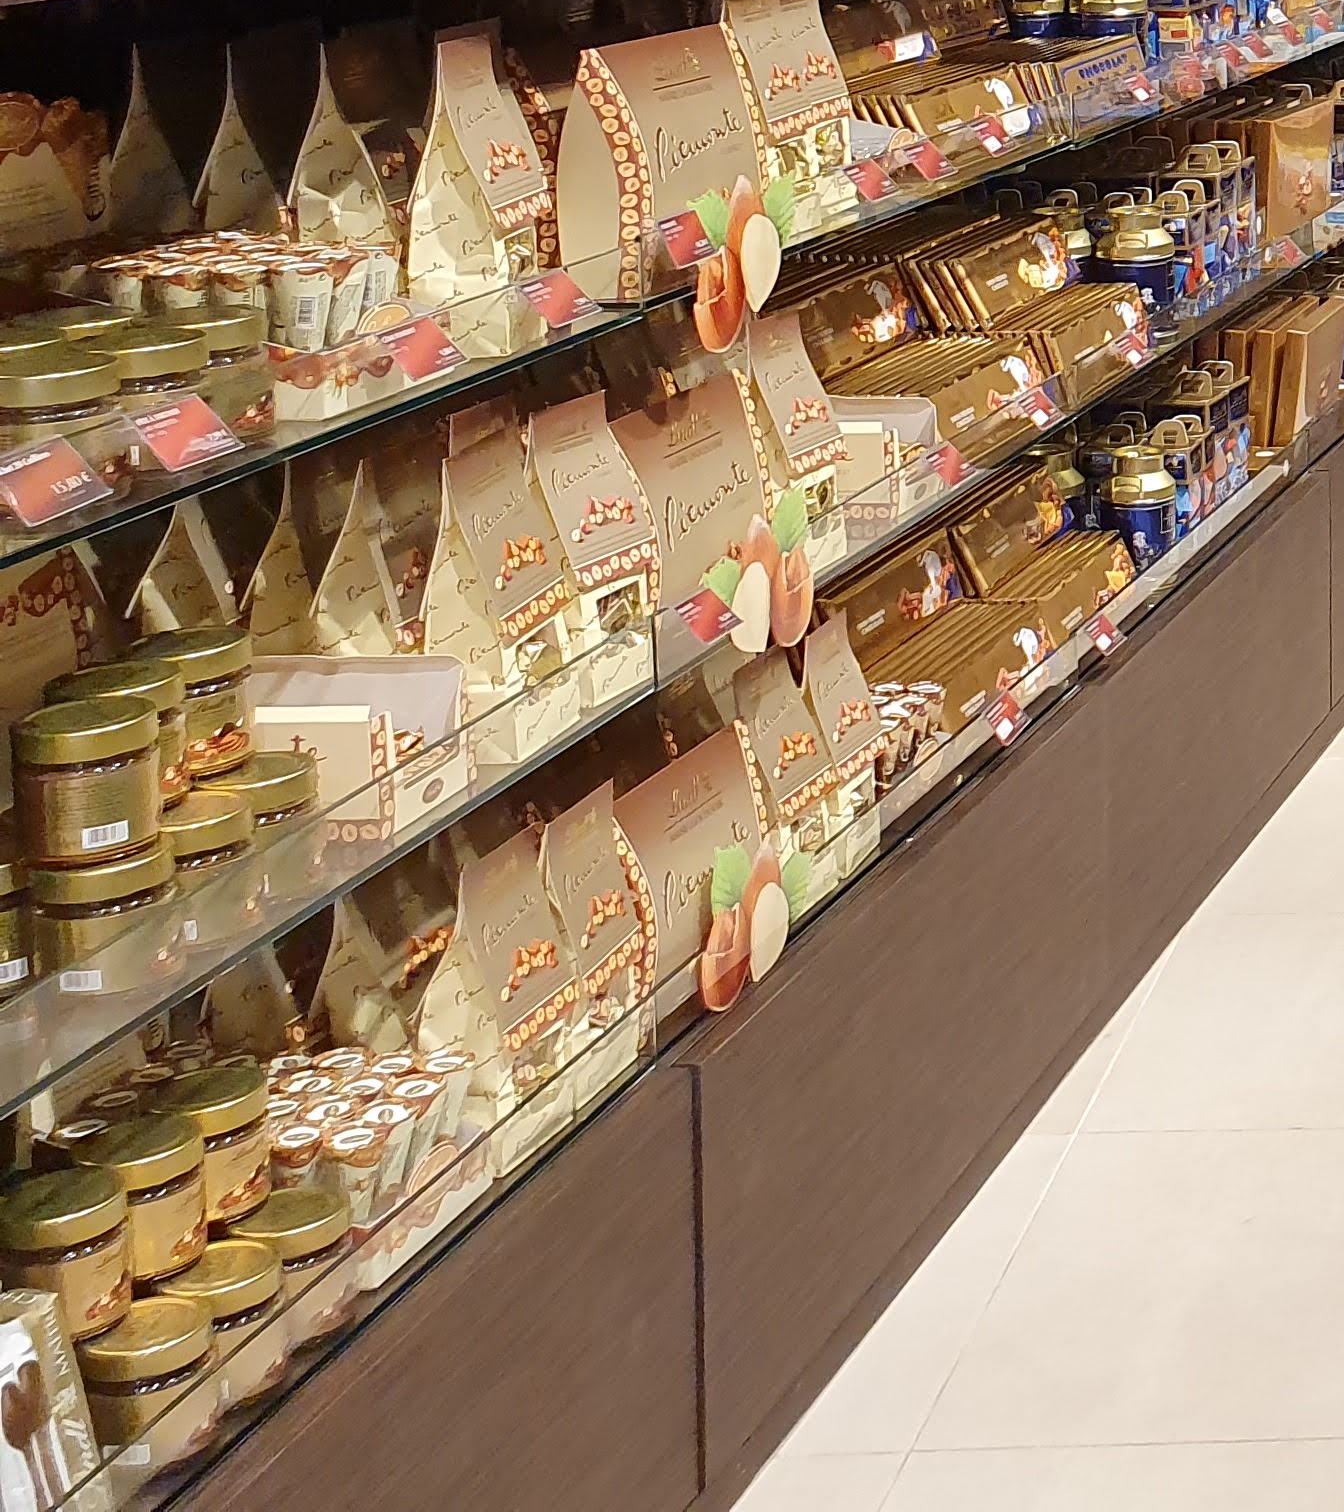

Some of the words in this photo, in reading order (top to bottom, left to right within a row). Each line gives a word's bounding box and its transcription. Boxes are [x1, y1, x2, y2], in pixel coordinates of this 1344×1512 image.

[653, 107, 745, 184] Piemonte
[552, 452, 611, 498] Piemonte
[664, 461, 754, 553] Piemonte
[472, 489, 525, 544] Piemonte
